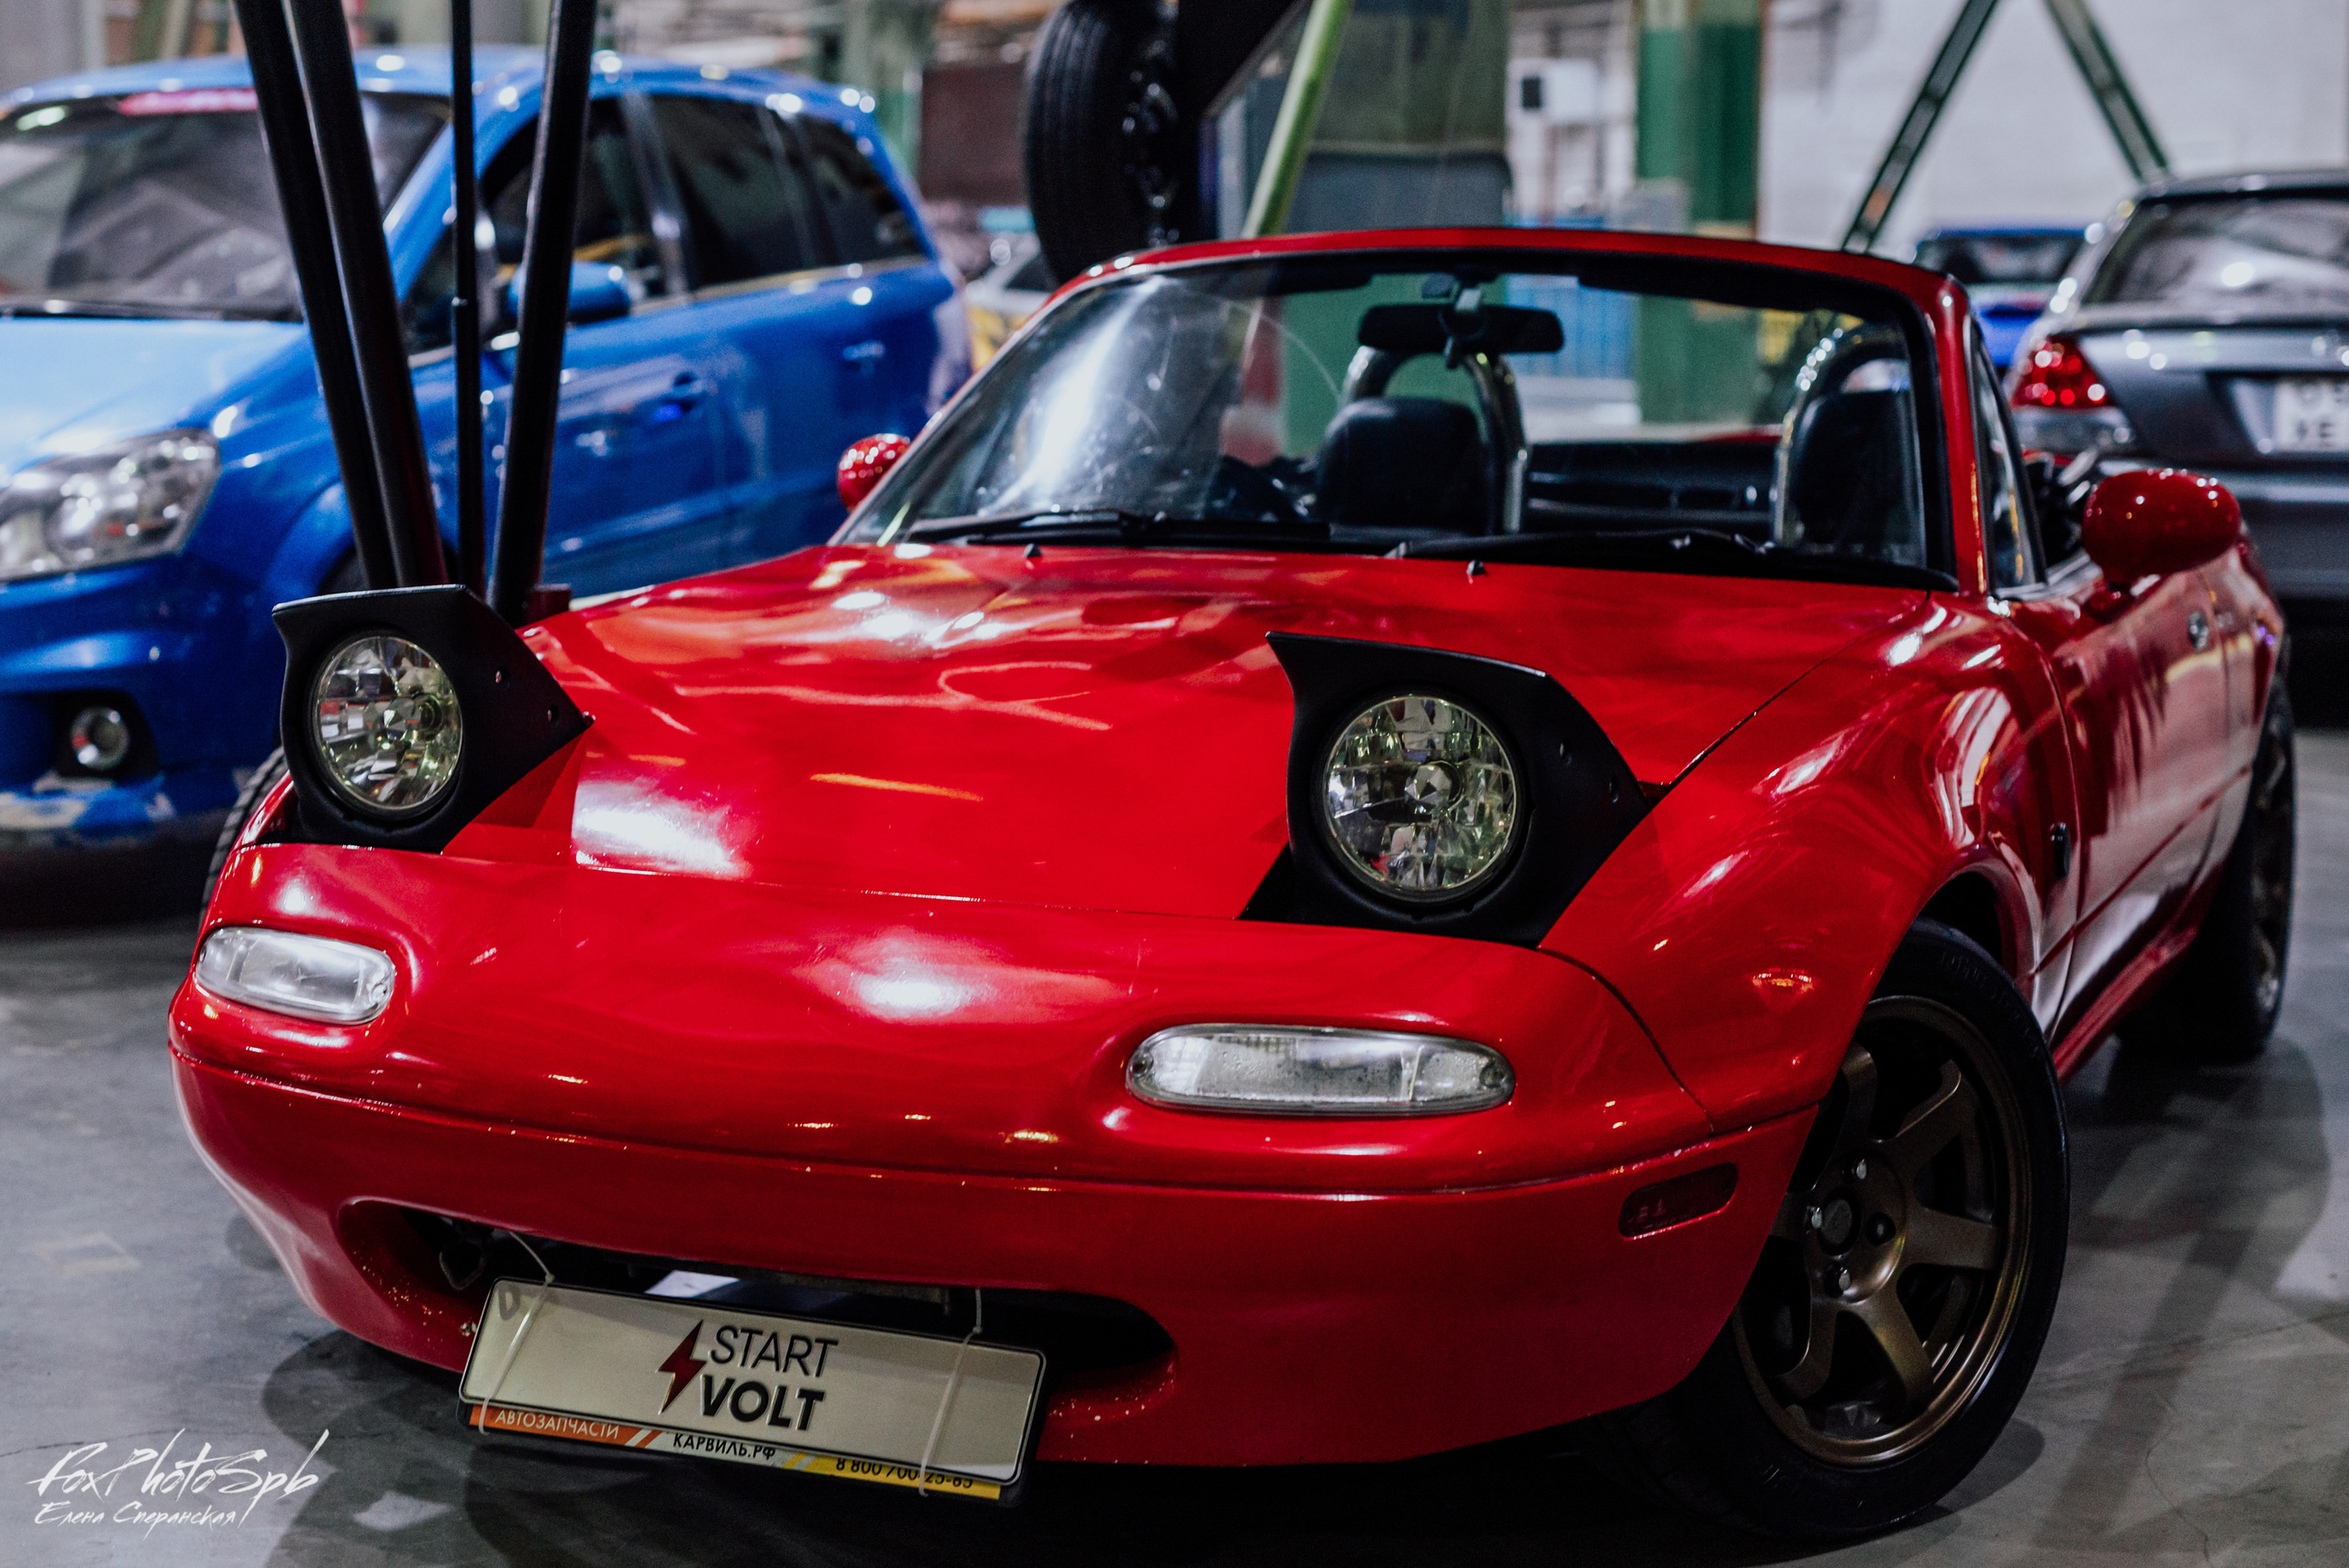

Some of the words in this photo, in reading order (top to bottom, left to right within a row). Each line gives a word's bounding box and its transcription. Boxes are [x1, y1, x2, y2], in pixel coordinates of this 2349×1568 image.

[709, 1325, 839, 1378] START
[700, 1374, 825, 1431] VOLT
[495, 1409, 619, 1440] АВТОЗАПЧАСТИ
[673, 1432, 777, 1461] КАРВИЛЬ.РФ
[851, 1460, 883, 1476] 800
